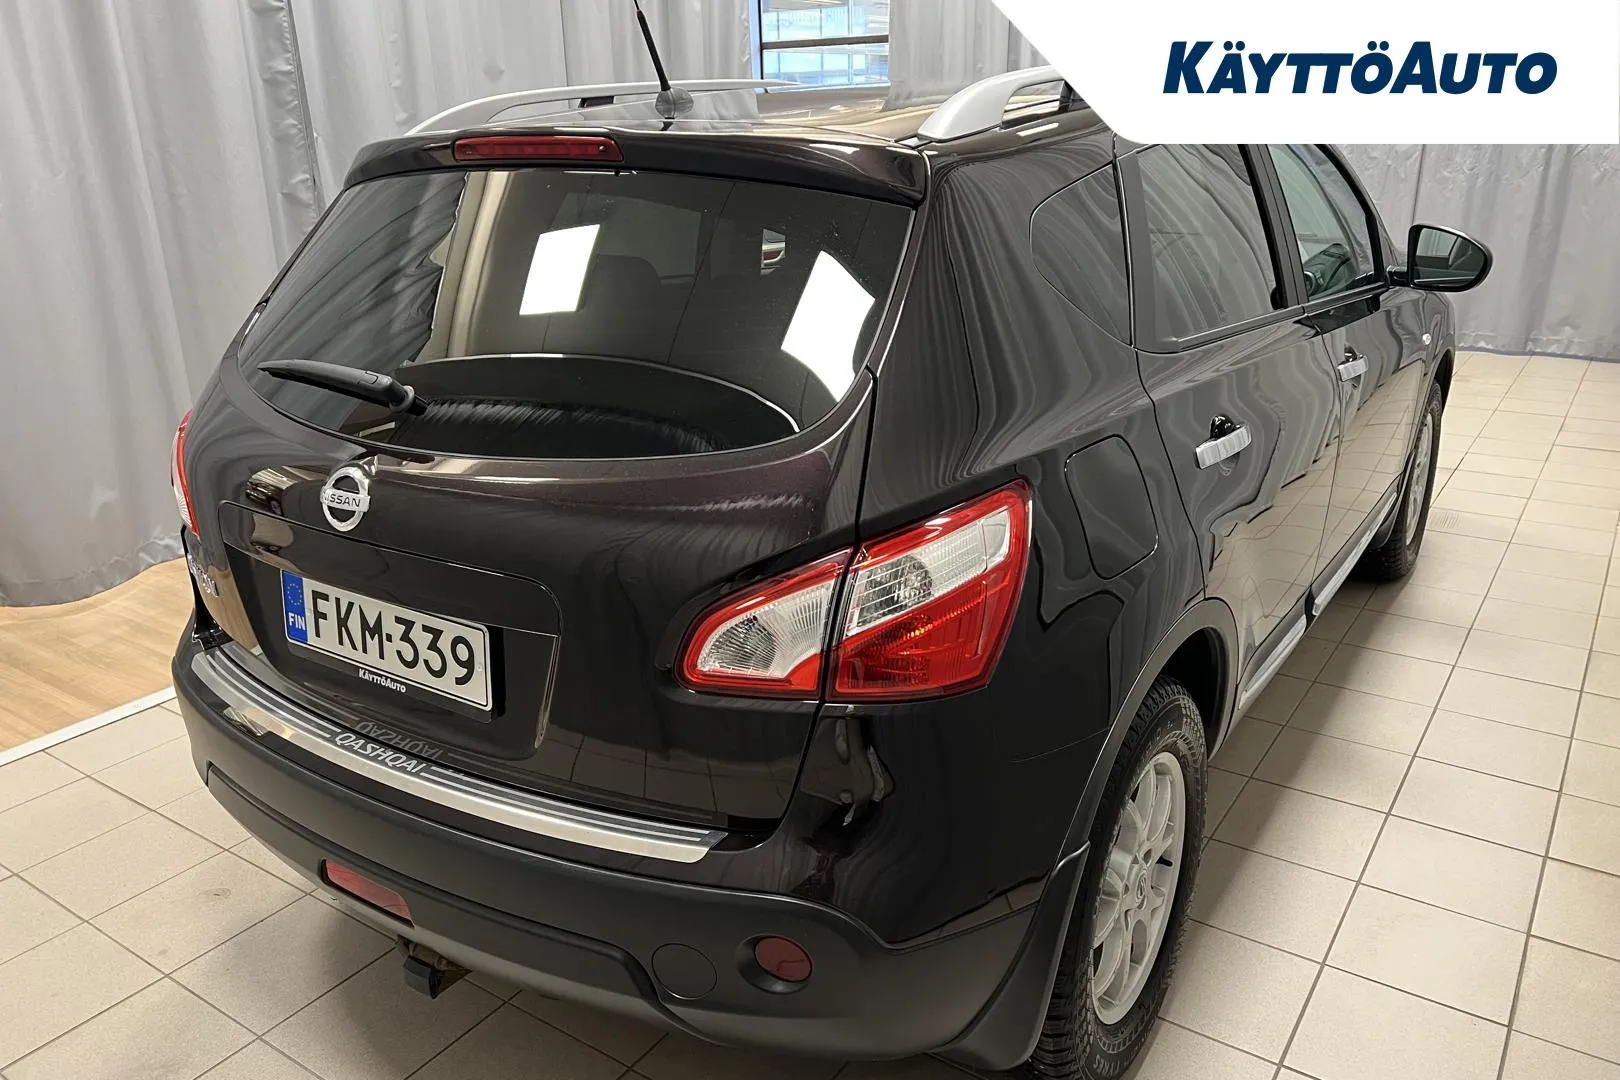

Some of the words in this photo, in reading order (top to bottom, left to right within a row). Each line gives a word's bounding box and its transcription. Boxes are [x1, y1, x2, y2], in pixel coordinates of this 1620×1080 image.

[289, 613, 306, 631] FIN
[311, 589, 475, 685] FKM-339
[336, 733, 426, 773] QASHQAI
